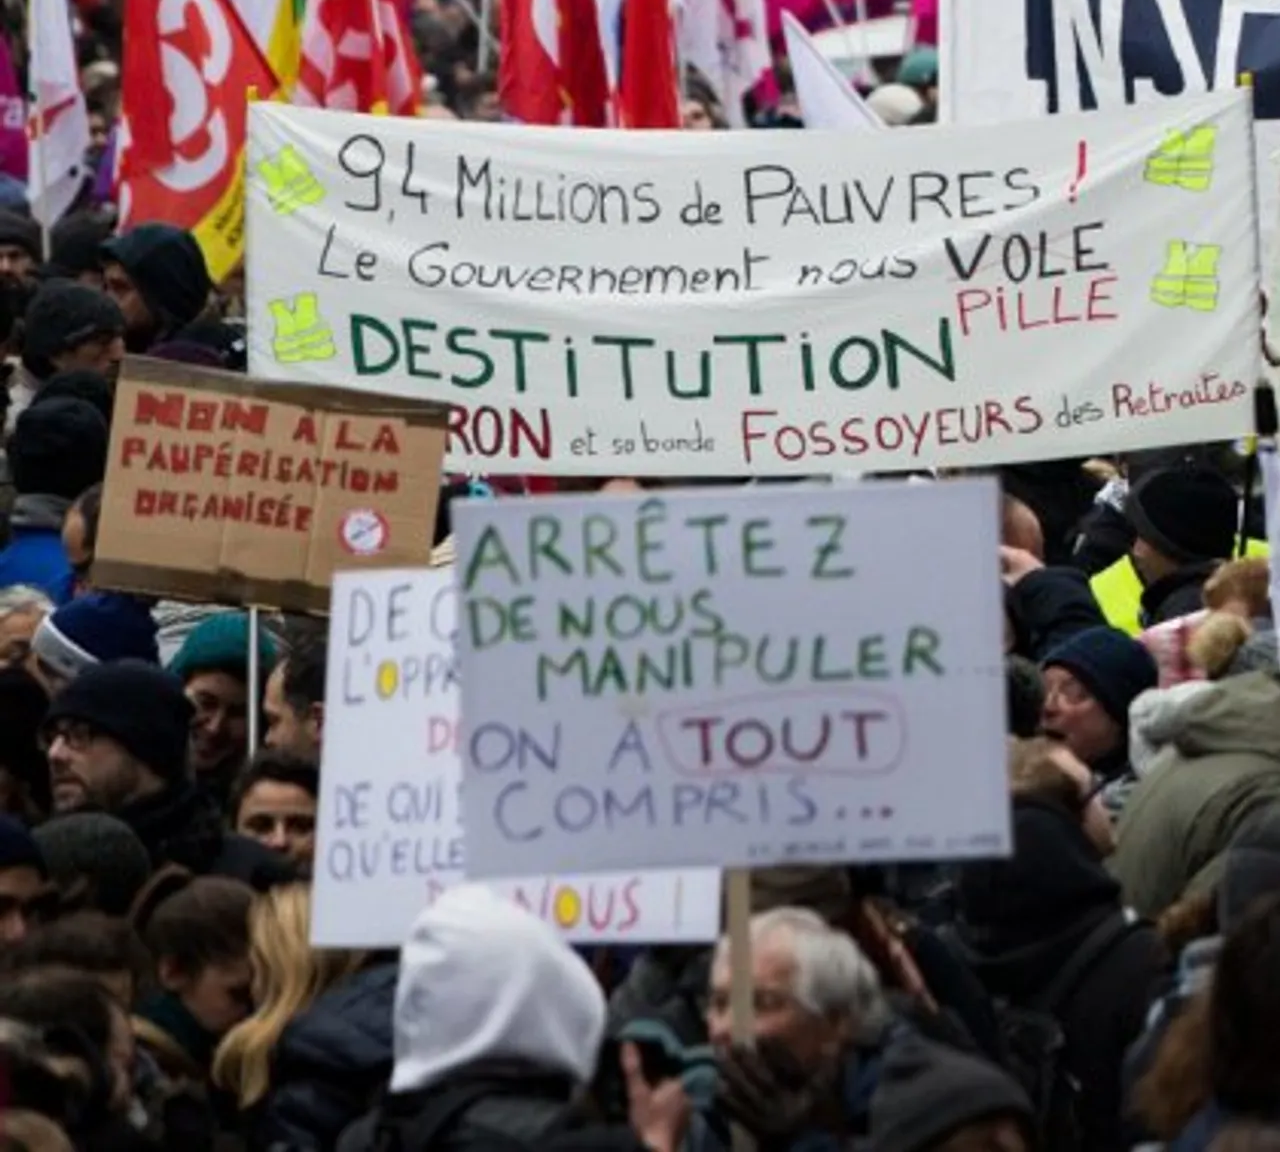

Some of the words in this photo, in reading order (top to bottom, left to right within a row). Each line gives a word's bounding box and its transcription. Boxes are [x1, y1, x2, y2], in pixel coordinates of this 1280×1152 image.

[338, 133, 430, 225] 9,4
[679, 179, 724, 227] de
[743, 163, 1041, 227] PAUVRES
[317, 222, 378, 282] Le
[797, 253, 919, 286] nous
[943, 221, 1110, 283] VOLE
[133, 390, 270, 435] NON
[335, 420, 400, 454] LA
[445, 404, 553, 460] RON
[570, 425, 599, 457] et
[740, 395, 1044, 464] FOSSOYEURS
[1053, 392, 1105, 429] des
[1110, 370, 1248, 419] Retraites
[464, 497, 858, 590] ARRÊTEZ
[347, 583, 413, 647] DE
[467, 595, 537, 650] DE
[558, 587, 727, 644] NOUS
[536, 624, 947, 703] MANIPULER
[469, 720, 561, 772] ON
[680, 710, 890, 768] TOUT
[333, 780, 374, 830] DE
[513, 875, 641, 933] NOUS
